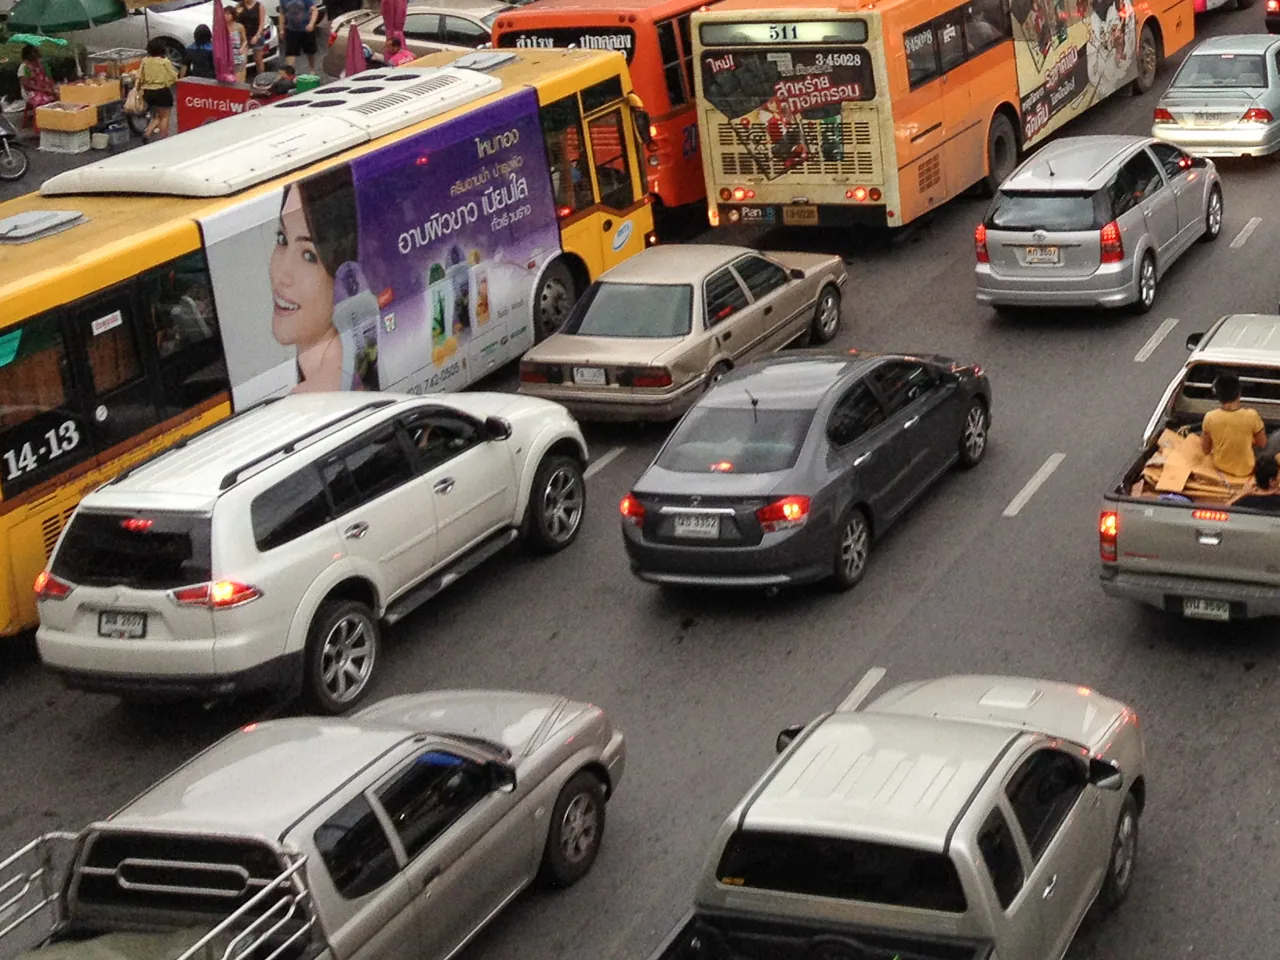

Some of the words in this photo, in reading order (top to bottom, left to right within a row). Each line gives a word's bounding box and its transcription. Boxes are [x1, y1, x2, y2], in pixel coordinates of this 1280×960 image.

[516, 34, 554, 48] สำโรง
[579, 34, 632, 49] ปากคลอง
[769, 26, 799, 41] 511
[705, 53, 736, 74] ใหม่!
[774, 76, 830, 99] สาหร่าย
[789, 85, 861, 113] ทอดกรอบ
[398, 202, 478, 254] อาบผิวขาว
[482, 173, 529, 216] เนียนใส
[742, 207, 761, 217] Plan
